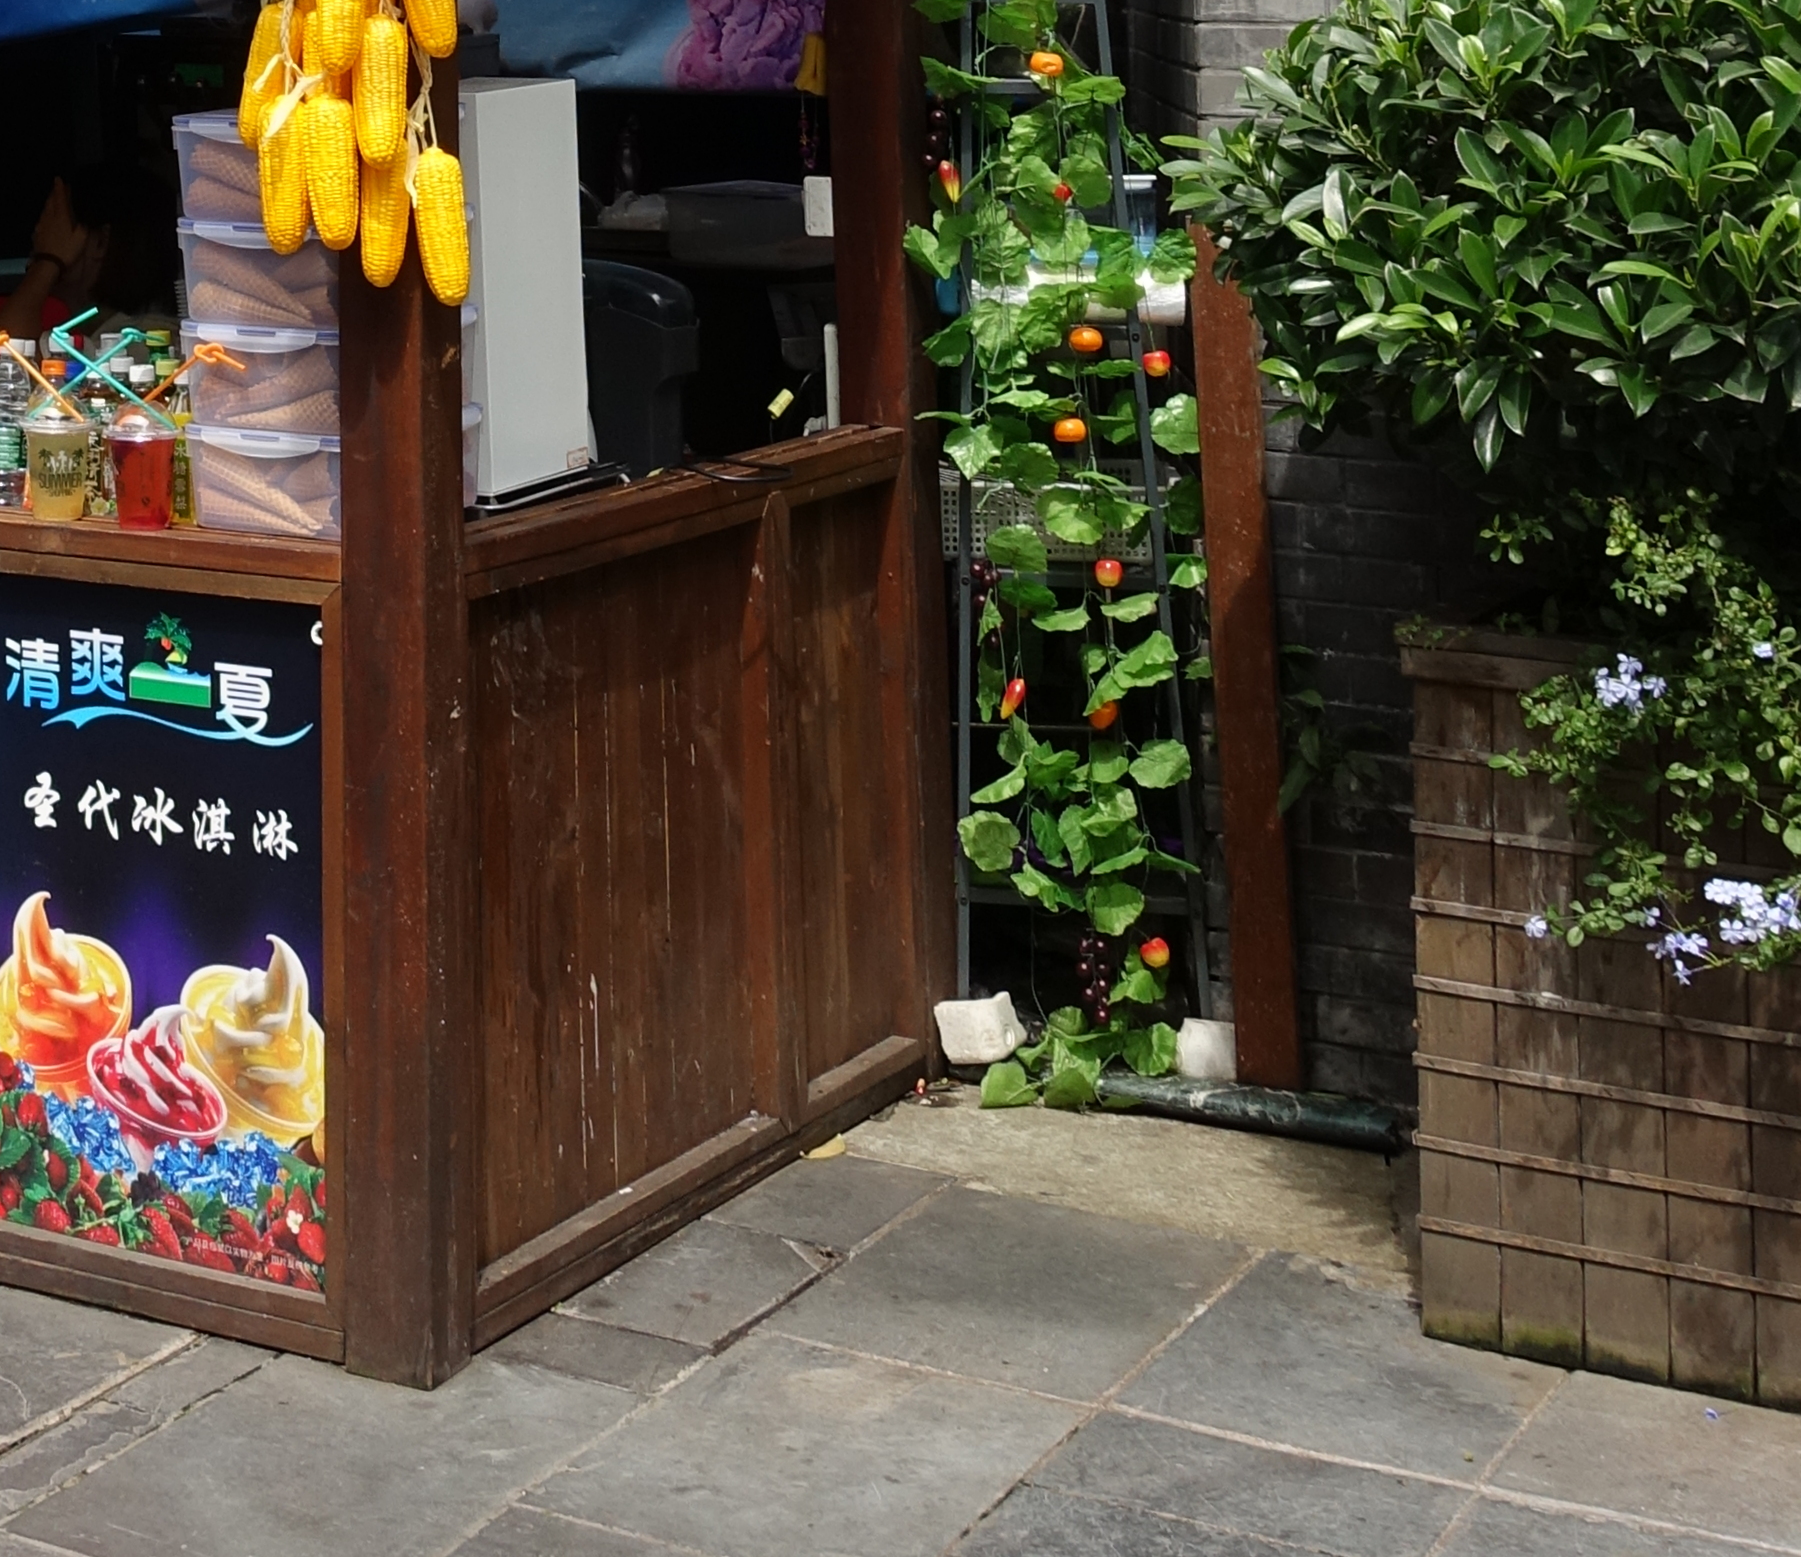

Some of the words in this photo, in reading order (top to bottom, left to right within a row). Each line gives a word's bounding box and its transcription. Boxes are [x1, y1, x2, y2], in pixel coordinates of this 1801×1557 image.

[23, 770, 299, 862] 圣代冰淇淋
